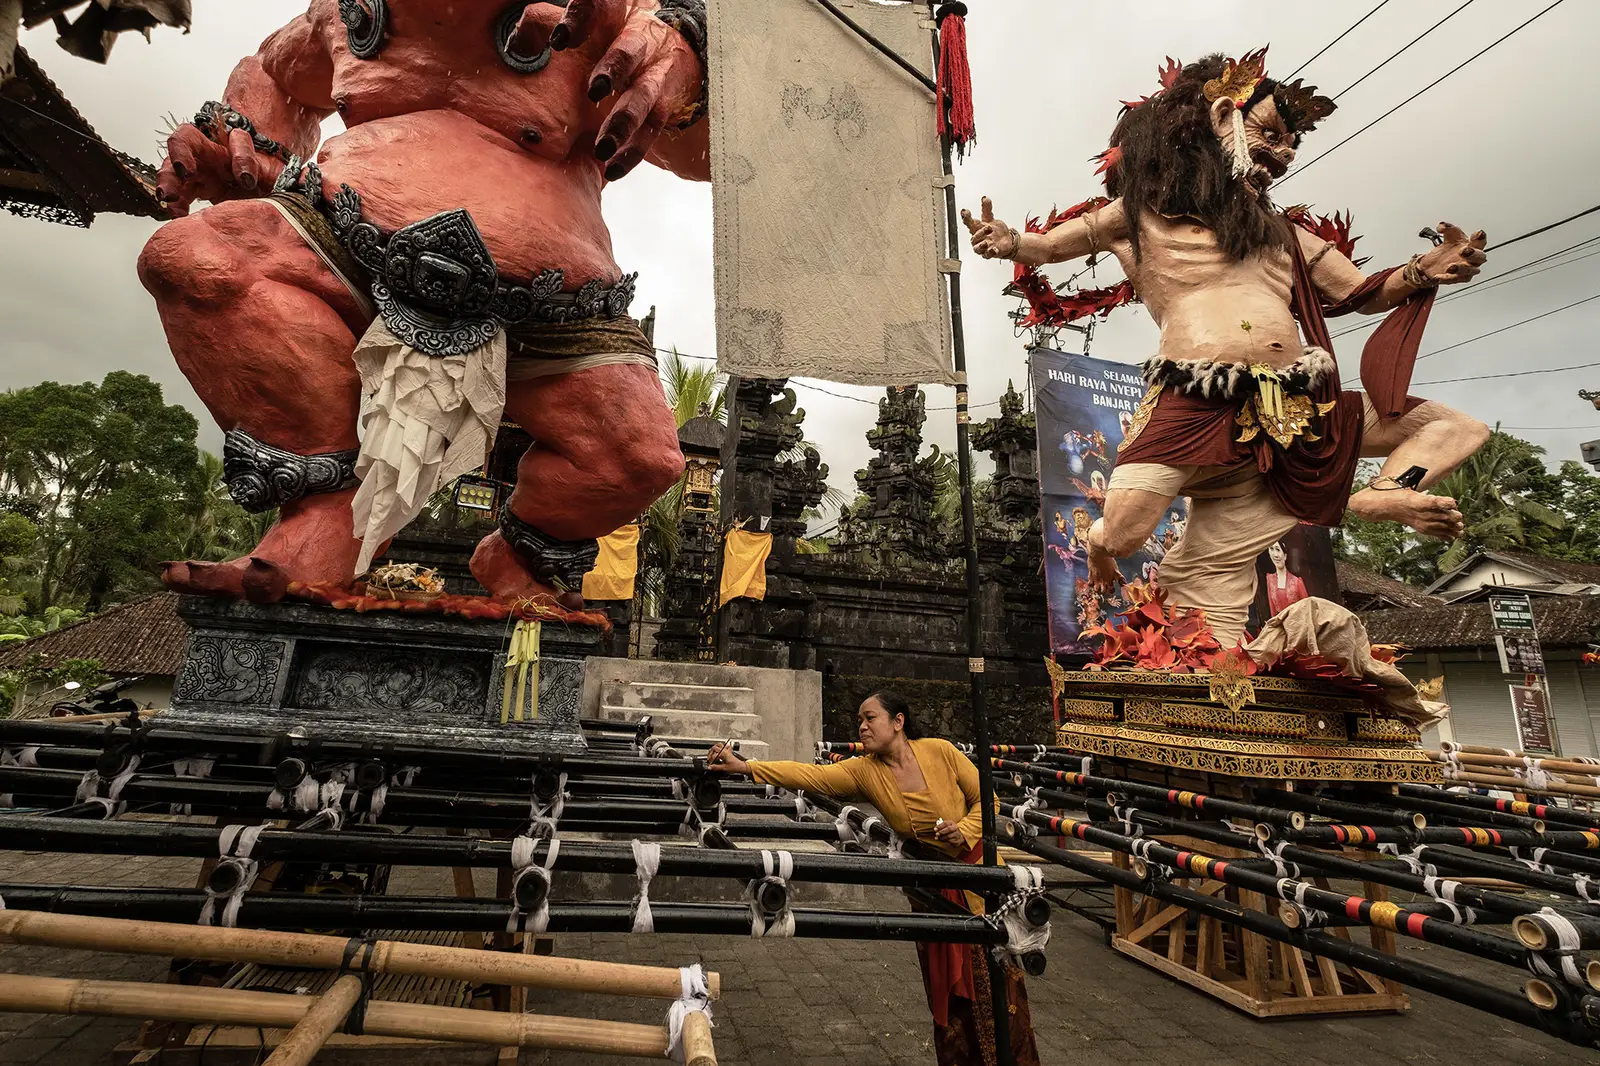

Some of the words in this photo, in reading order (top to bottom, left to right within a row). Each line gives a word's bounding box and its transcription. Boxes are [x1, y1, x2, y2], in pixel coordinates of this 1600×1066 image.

[1048, 369, 1075, 384] HARI
[1079, 376, 1107, 392] RAYA
[1110, 382, 1142, 398] NYEPI
[1103, 369, 1144, 386] SELAMAT
[1093, 394, 1131, 411] BANJAR
